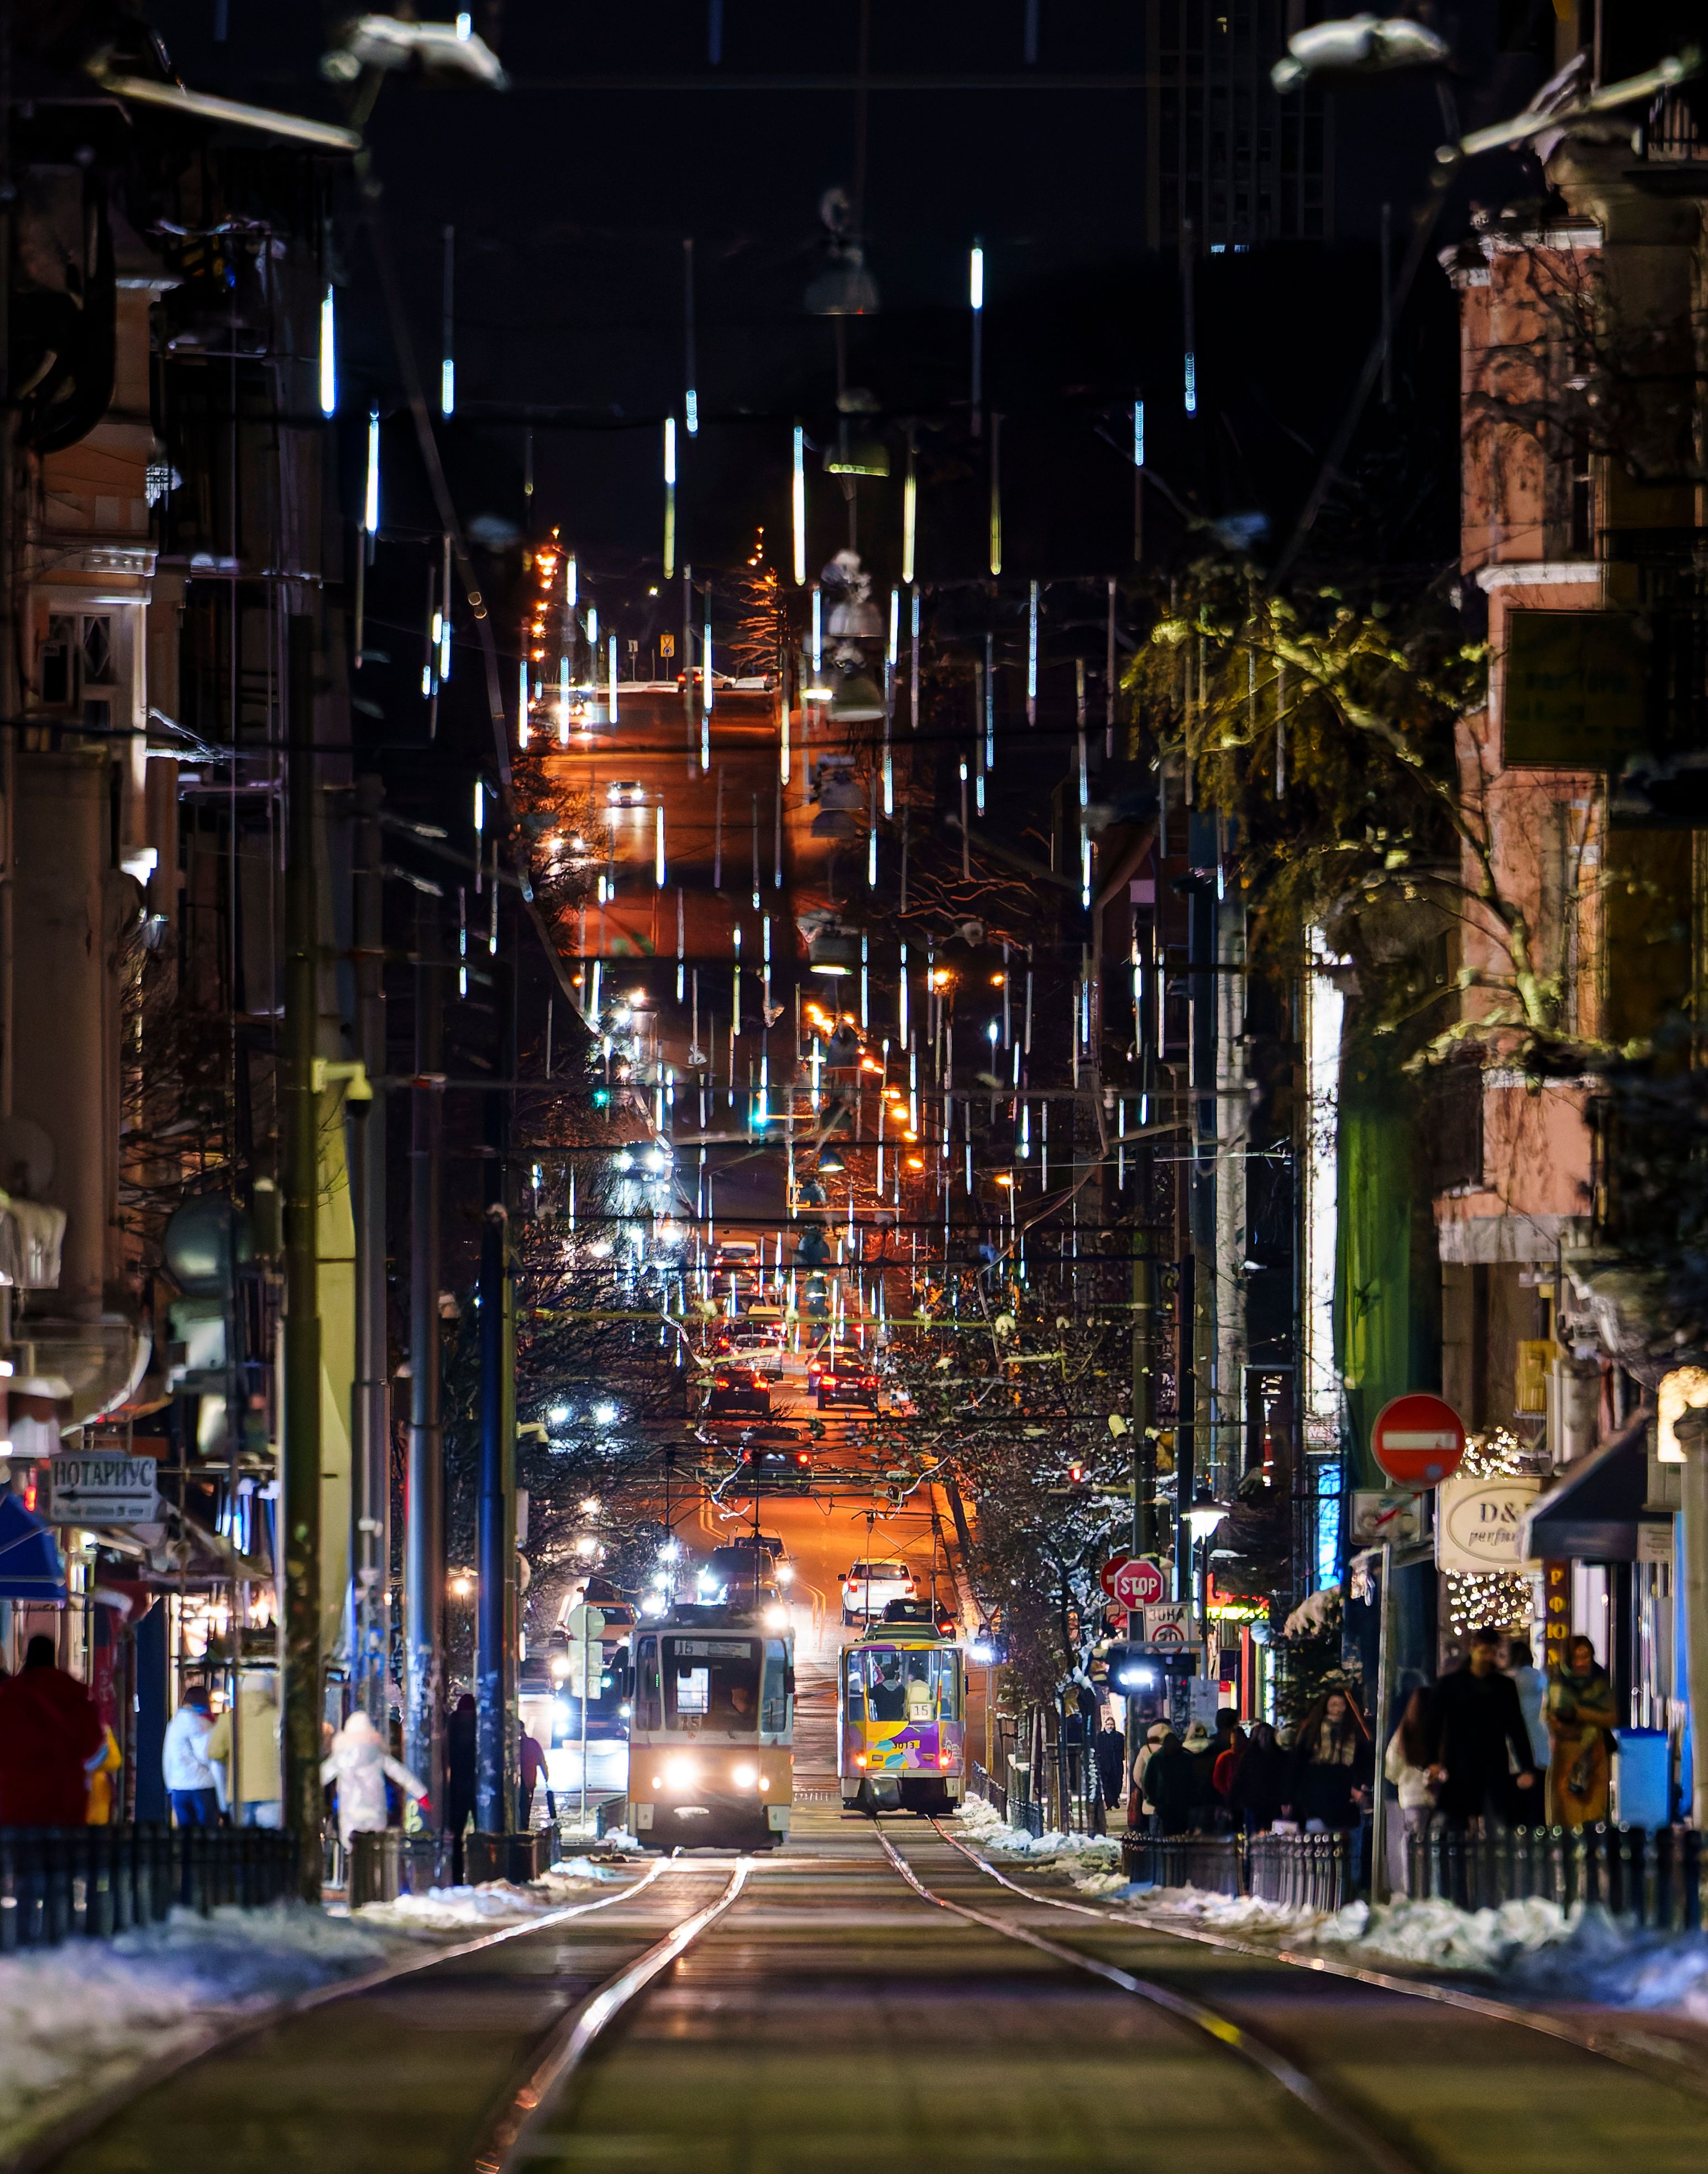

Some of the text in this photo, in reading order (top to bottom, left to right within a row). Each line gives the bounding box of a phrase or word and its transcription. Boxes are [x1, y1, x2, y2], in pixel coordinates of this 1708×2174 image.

[54, 1461, 153, 1486] НОТАРИУС
[1480, 1502, 1533, 1522] D&
[1468, 1527, 1516, 1546] perfu
[1120, 1577, 1158, 1595] STOP
[914, 1705, 928, 1716] 15
[683, 1715, 699, 1730] 15
